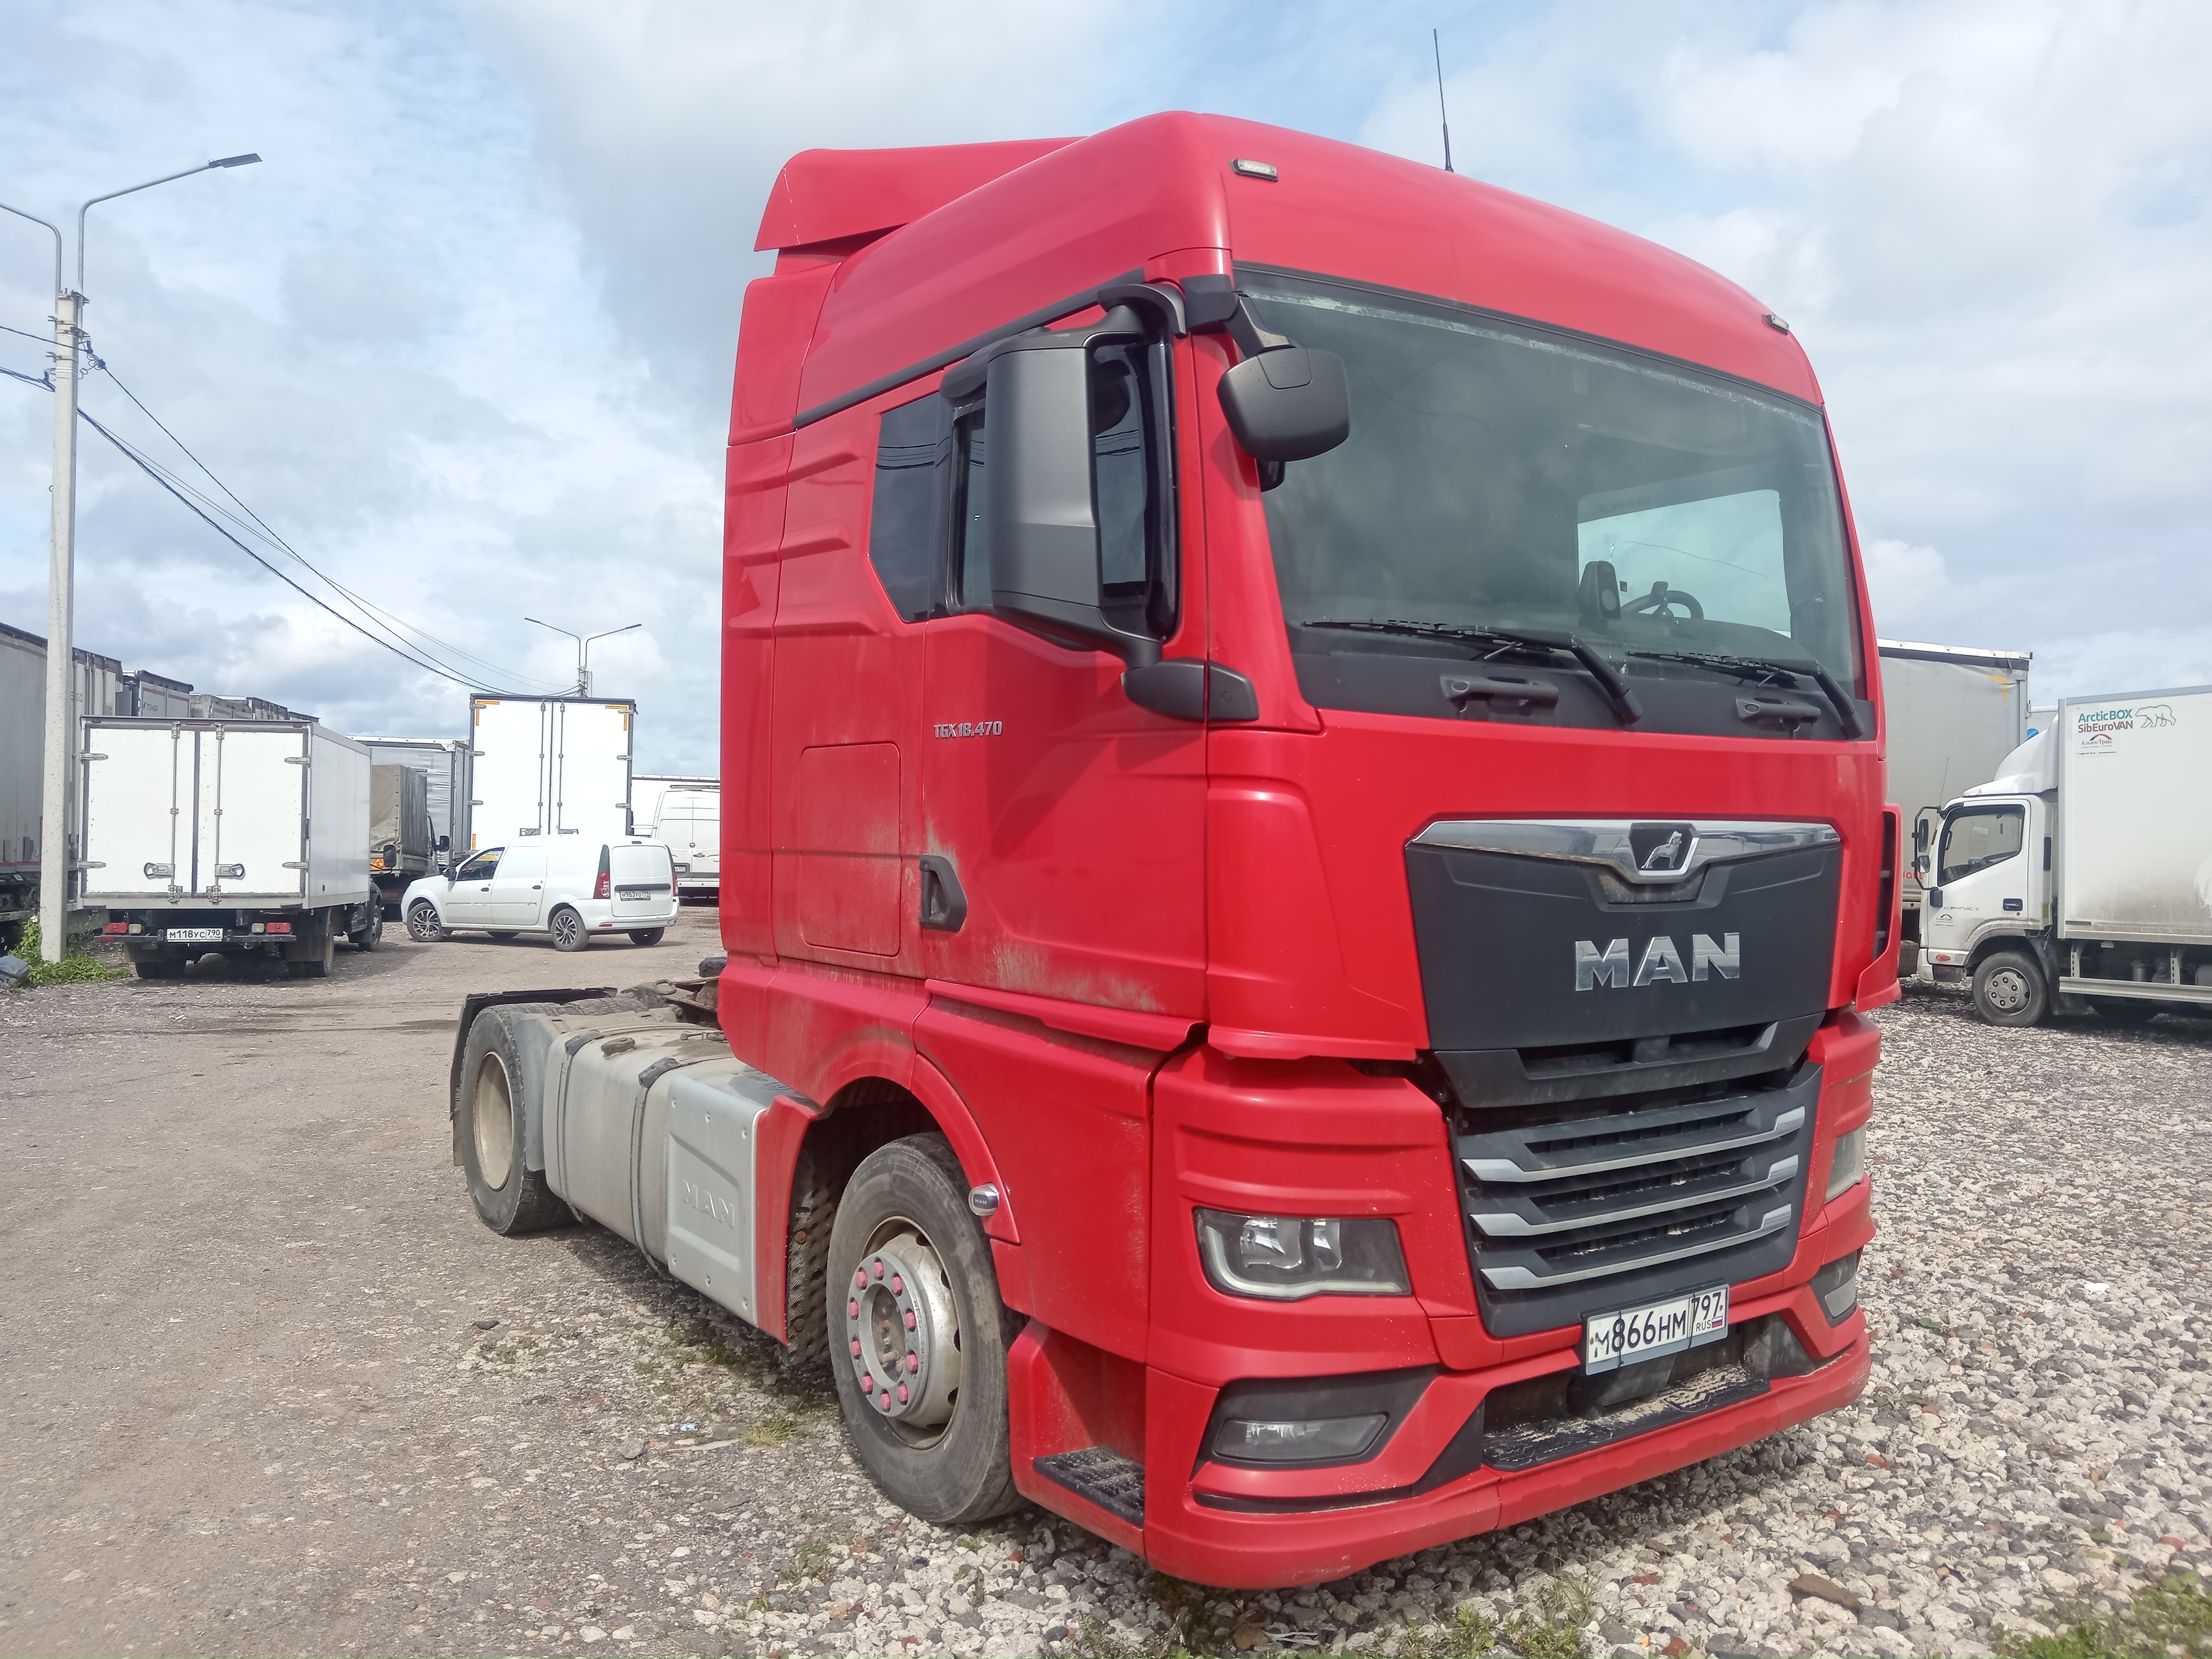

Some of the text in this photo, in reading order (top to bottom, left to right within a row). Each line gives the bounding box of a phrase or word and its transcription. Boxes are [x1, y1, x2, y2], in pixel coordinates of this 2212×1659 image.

[2078, 720, 2133, 733] SibEuroVAN
[170, 930, 205, 938] М118УС
[1575, 932, 1740, 991] MAN
[683, 1179, 734, 1229] MAN
[1594, 1291, 1722, 1358] М866НМ 797
[1696, 1320, 1711, 1332] RUS
